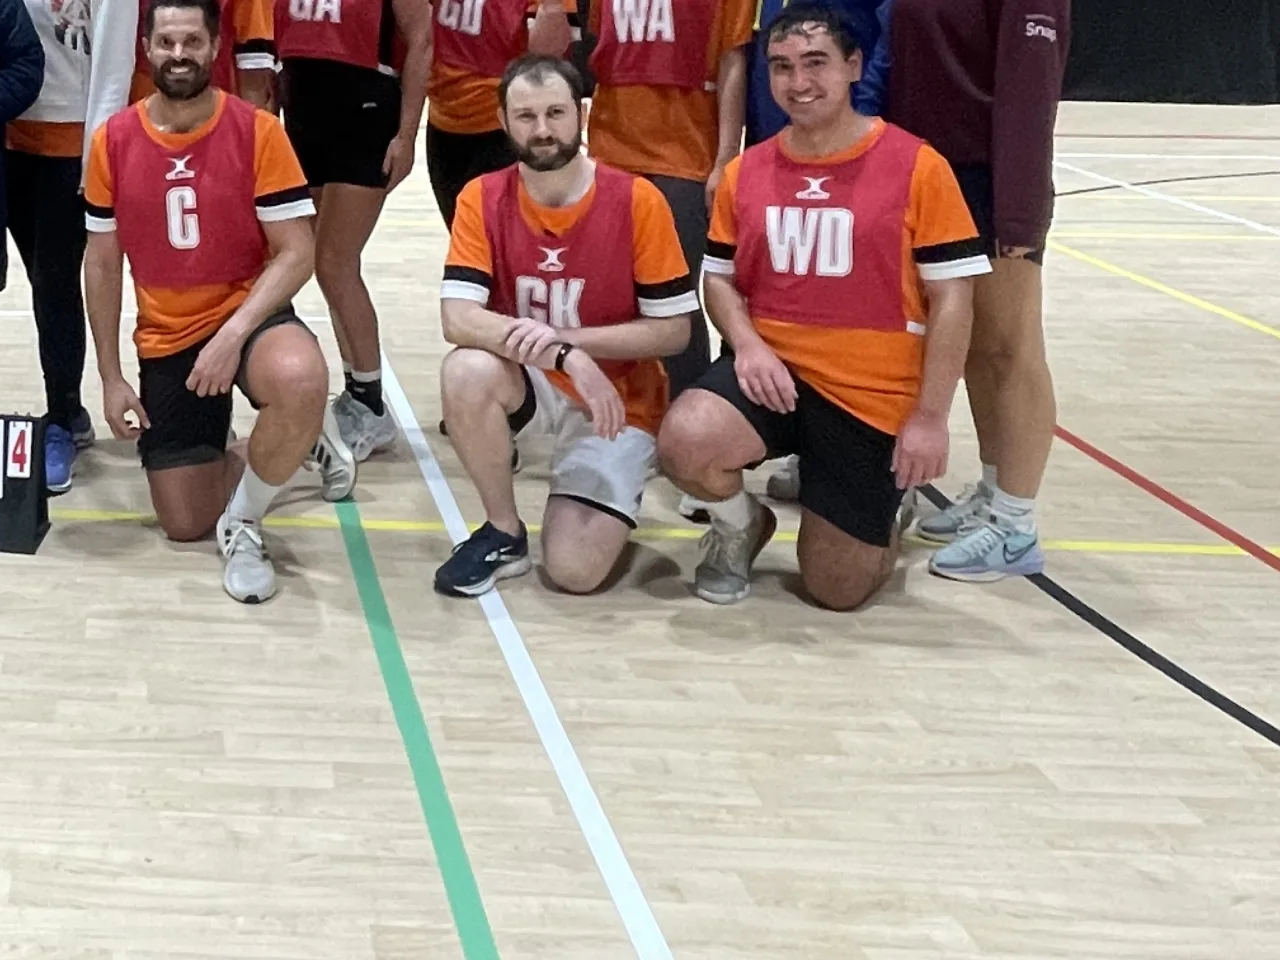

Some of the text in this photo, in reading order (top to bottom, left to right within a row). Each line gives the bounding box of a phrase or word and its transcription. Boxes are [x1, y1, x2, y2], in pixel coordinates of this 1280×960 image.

[166, 186, 200, 250] C
[765, 206, 854, 276] WD
[516, 275, 586, 328] GK
[11, 429, 27, 472] 4
